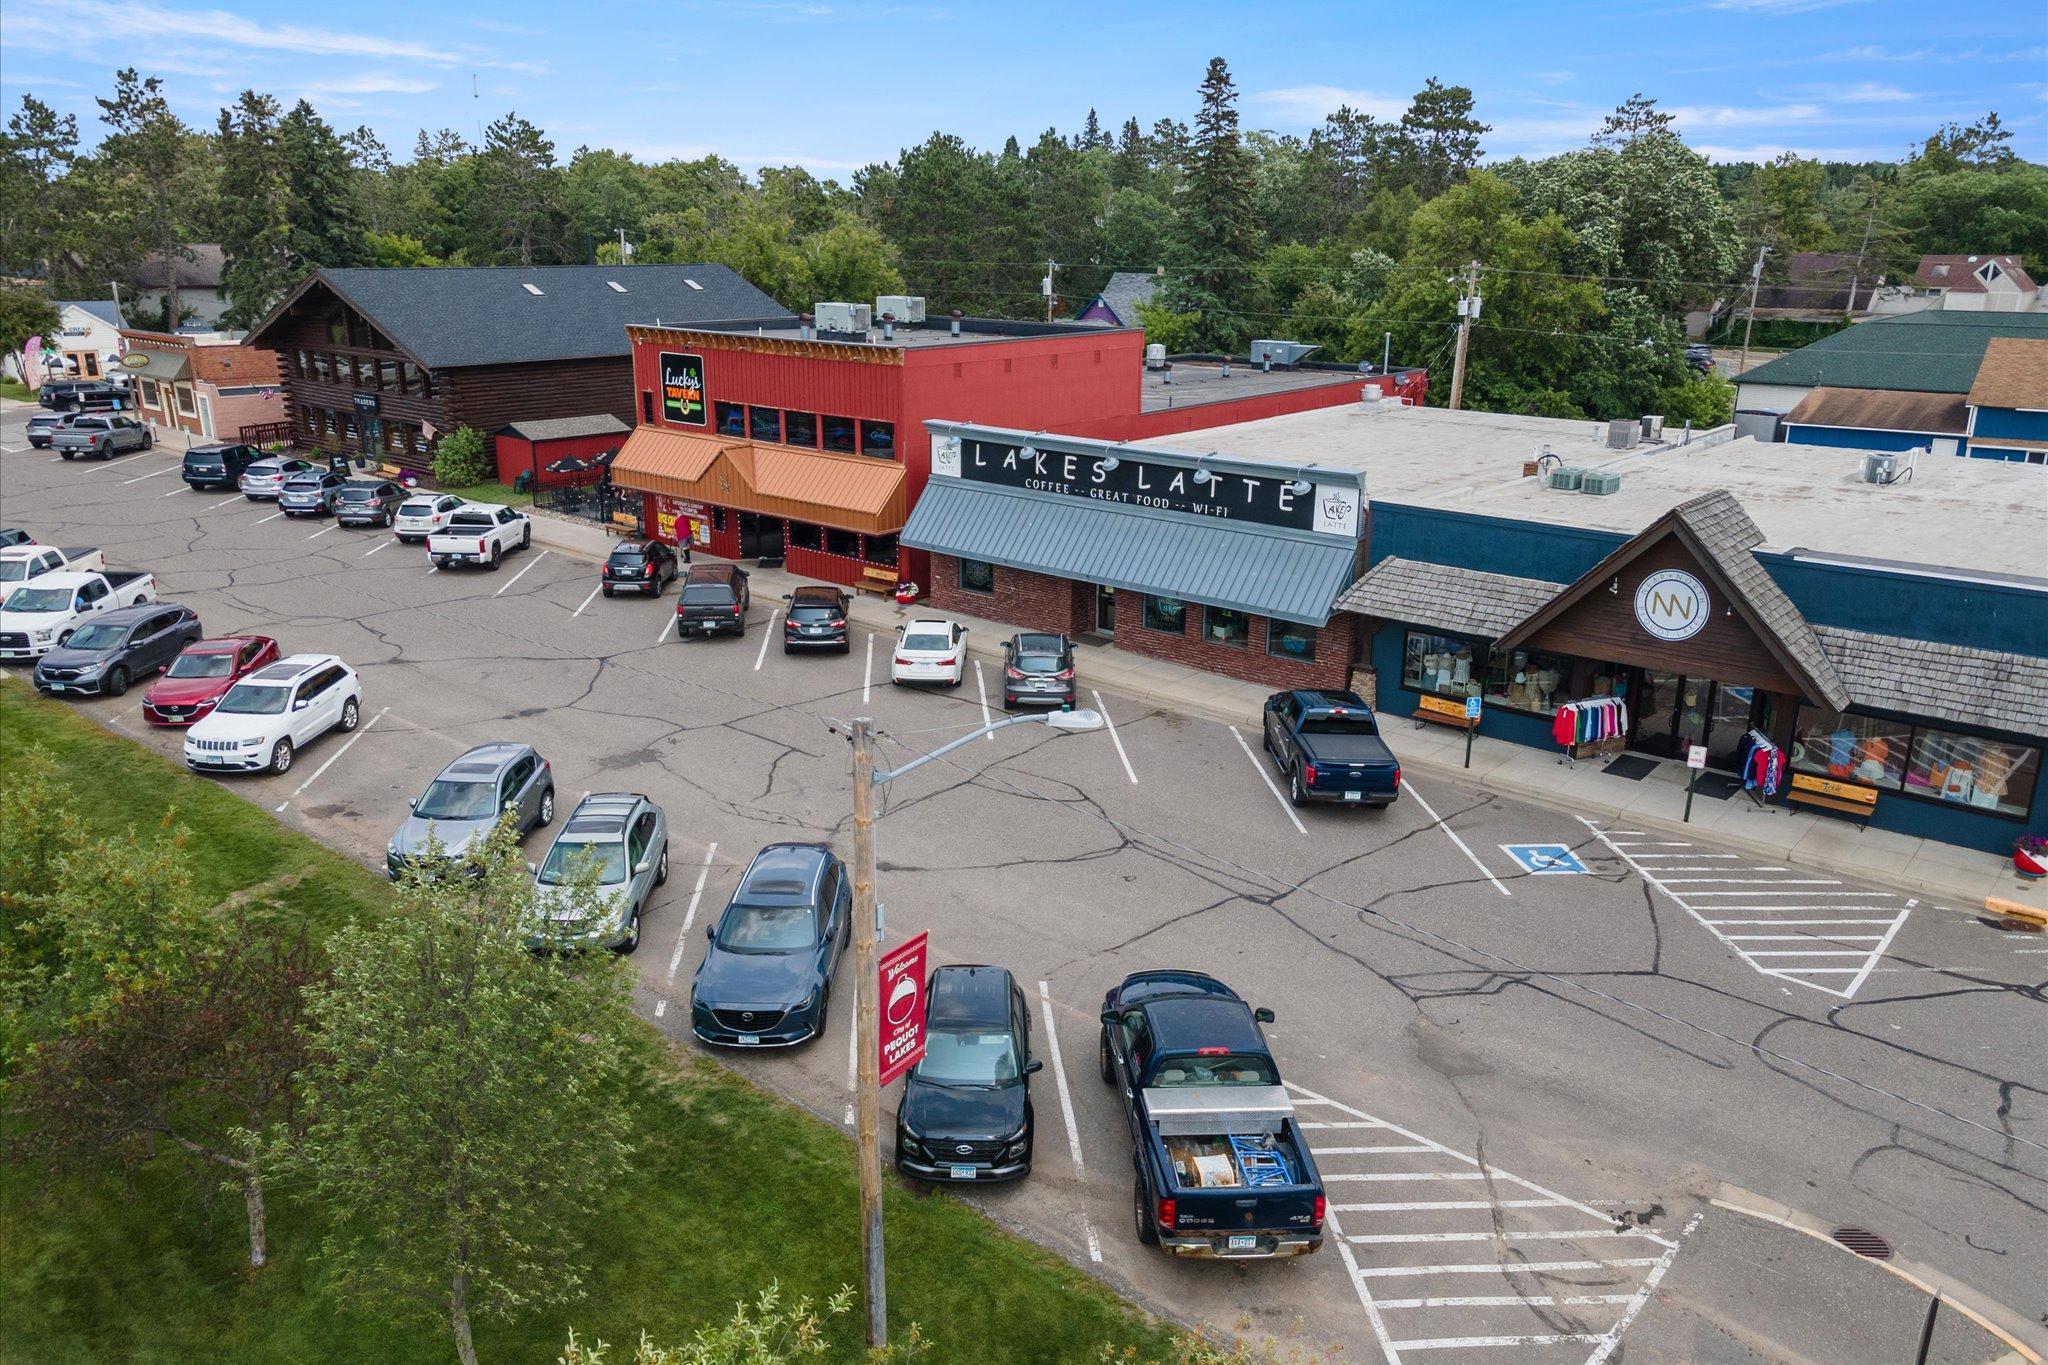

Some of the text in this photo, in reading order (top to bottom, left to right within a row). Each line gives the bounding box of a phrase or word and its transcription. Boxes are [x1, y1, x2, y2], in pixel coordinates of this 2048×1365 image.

[666, 387, 700, 400] TAVERN
[975, 444, 1106, 483] LAKES
[1025, 478, 1070, 494] COFFEE
[1090, 488, 1129, 503] GREAT
[1136, 494, 1169, 509] FOOD
[1192, 502, 1229, 518] WI-FI
[1641, 573, 1706, 604] NEAR NORTH
[887, 955, 919, 982] Welcome
[884, 1023, 919, 1056] PEQUOT
[893, 1019, 912, 1036] City of
[889, 1038, 916, 1065] LAKES
